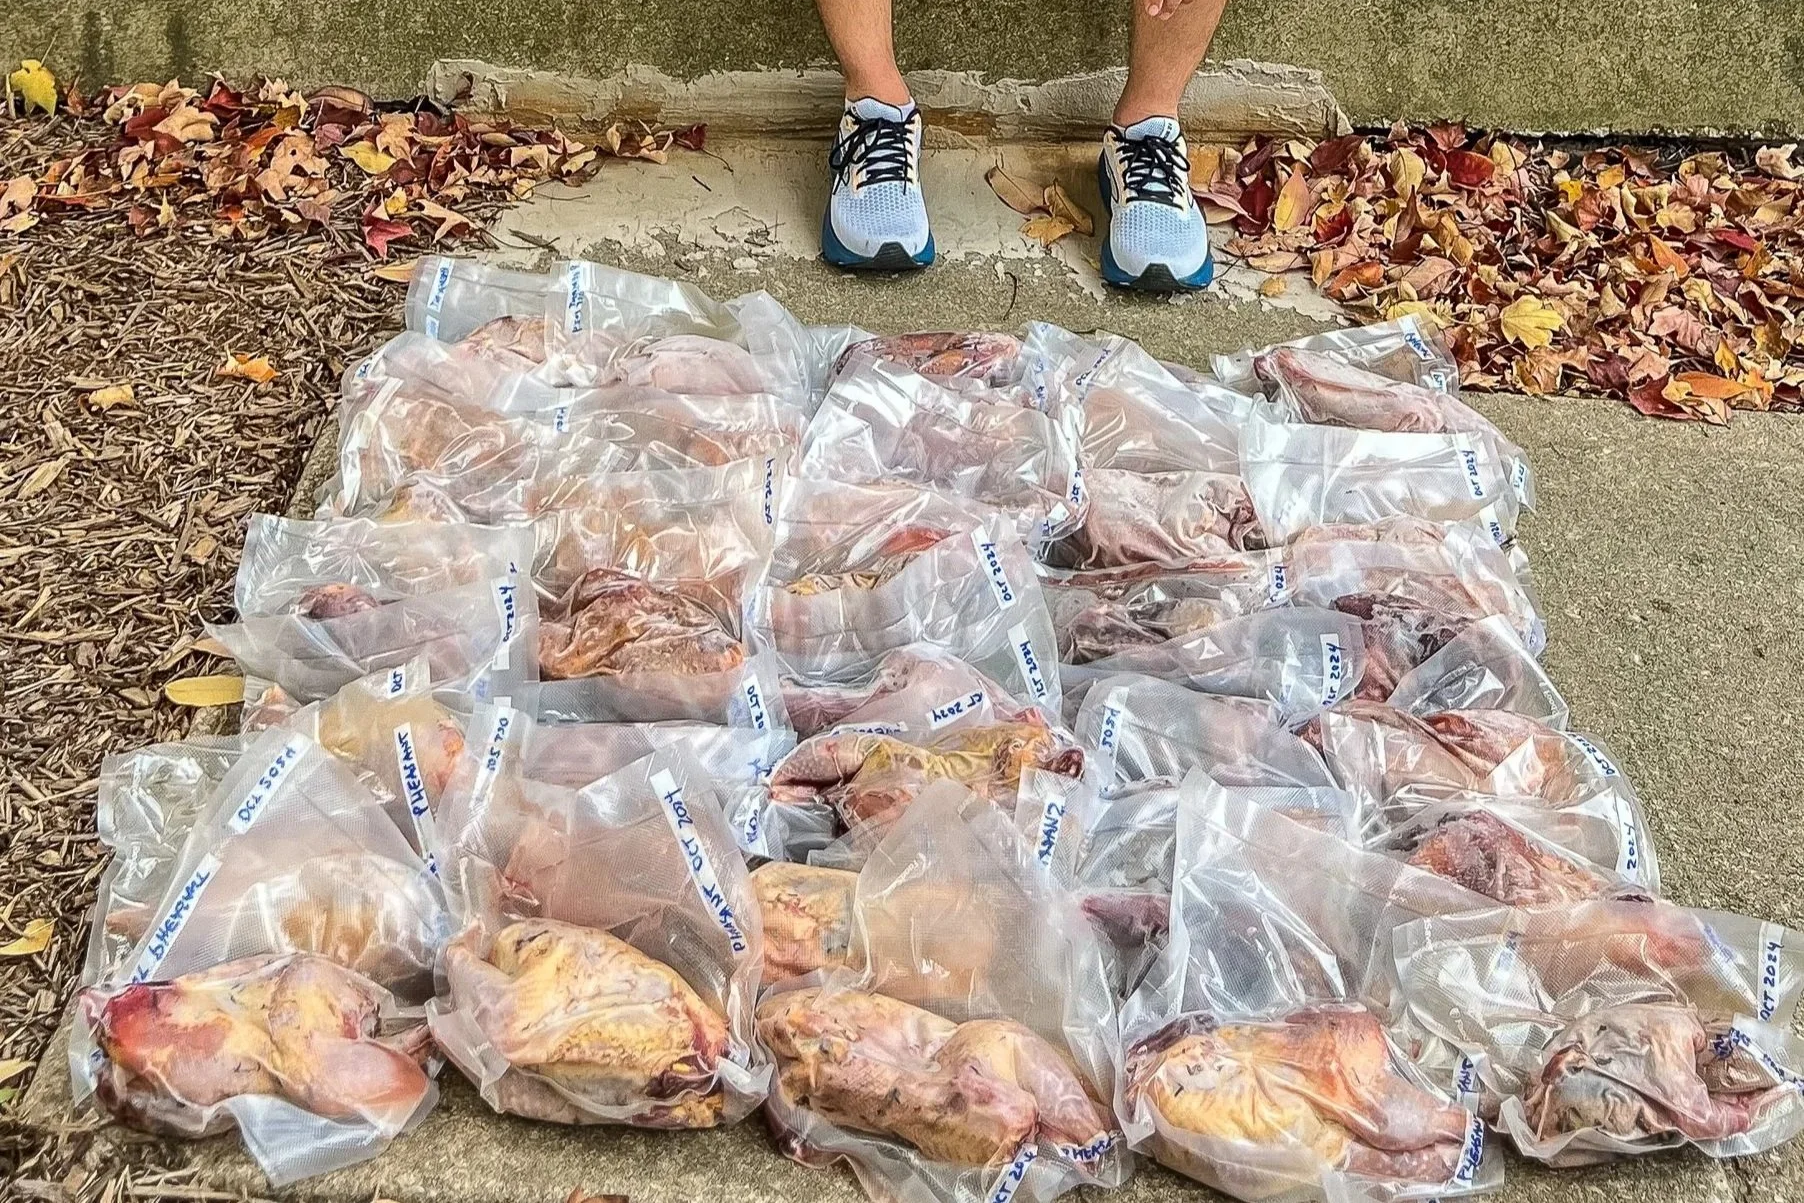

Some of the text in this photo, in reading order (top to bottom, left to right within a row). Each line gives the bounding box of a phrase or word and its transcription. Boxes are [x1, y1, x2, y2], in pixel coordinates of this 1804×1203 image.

[764, 458, 775, 499] 2024
[1461, 450, 1483, 497] OCT 2024
[980, 543, 1012, 602] OCT 2024
[498, 585, 516, 620] 2024
[1020, 640, 1038, 675] 2024
[1326, 642, 1348, 680] 2024
[391, 671, 402, 694] OCT
[747, 685, 760, 709] OCT
[931, 702, 964, 723] 2024
[397, 732, 429, 817] PHEASANT
[681, 836, 703, 872] OCT
[1623, 821, 1637, 871] 2024
[1759, 941, 1785, 1021] OCT 2024
[992, 1181, 1012, 1203] CT
